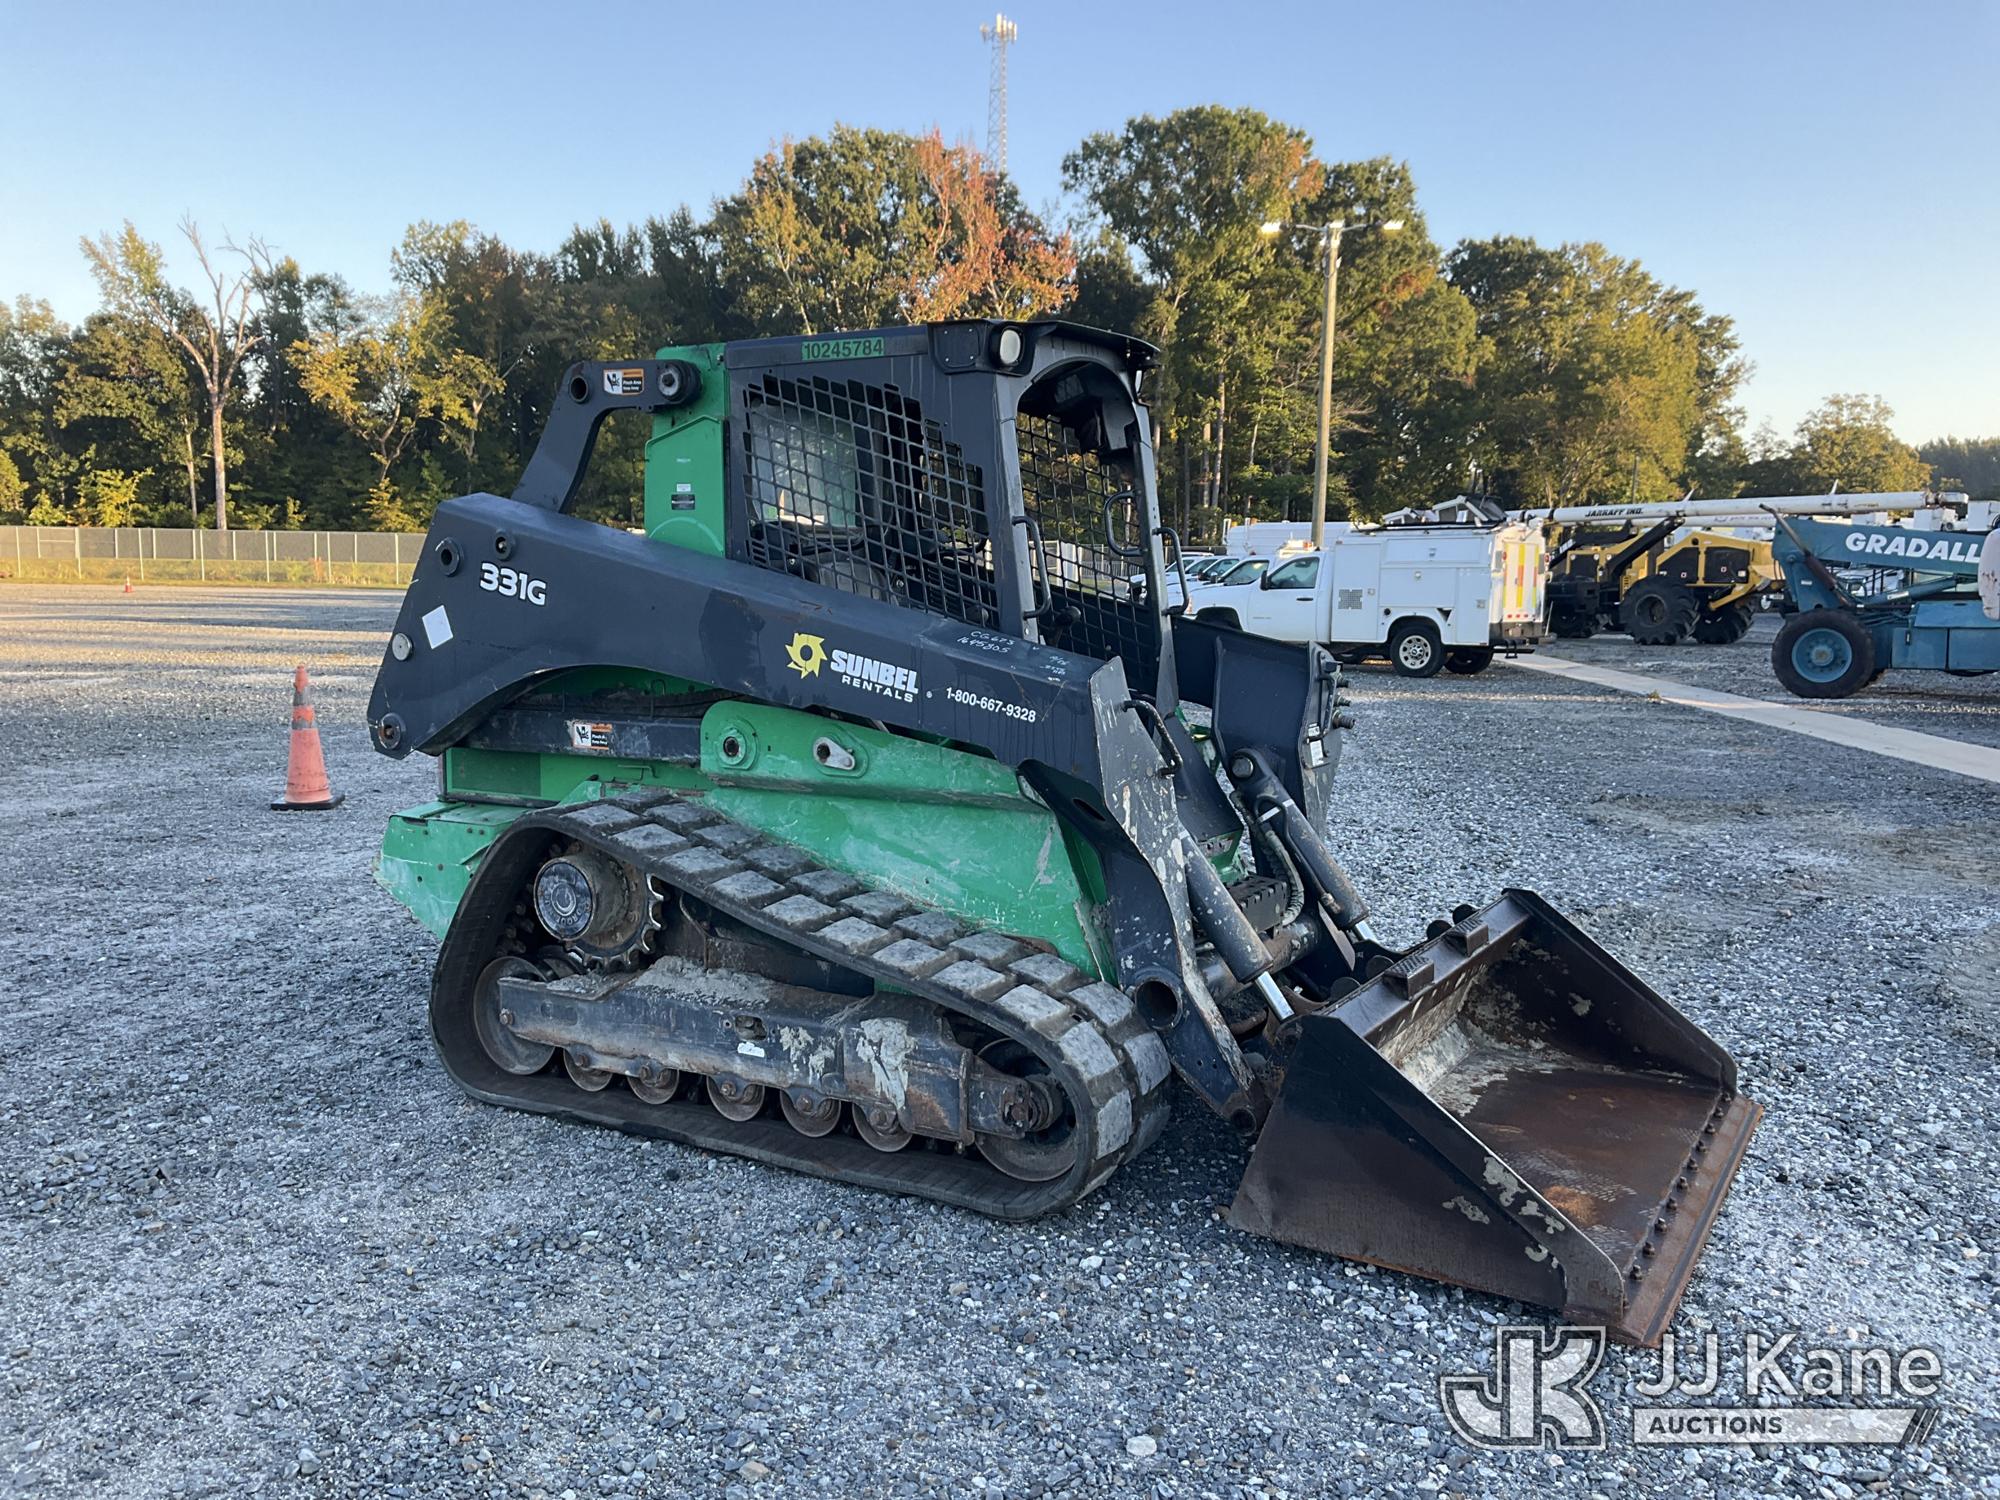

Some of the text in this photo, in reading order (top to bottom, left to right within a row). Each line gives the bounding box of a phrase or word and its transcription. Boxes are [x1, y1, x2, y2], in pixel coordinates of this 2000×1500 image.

[804, 339, 883, 359] 10245784
[1845, 532, 1981, 563] GRADALL
[479, 562, 547, 606] 331G
[830, 649, 919, 694] SUNBEL
[842, 674, 914, 703] RENTALS
[946, 687, 1036, 723] 1-800-667-9328
